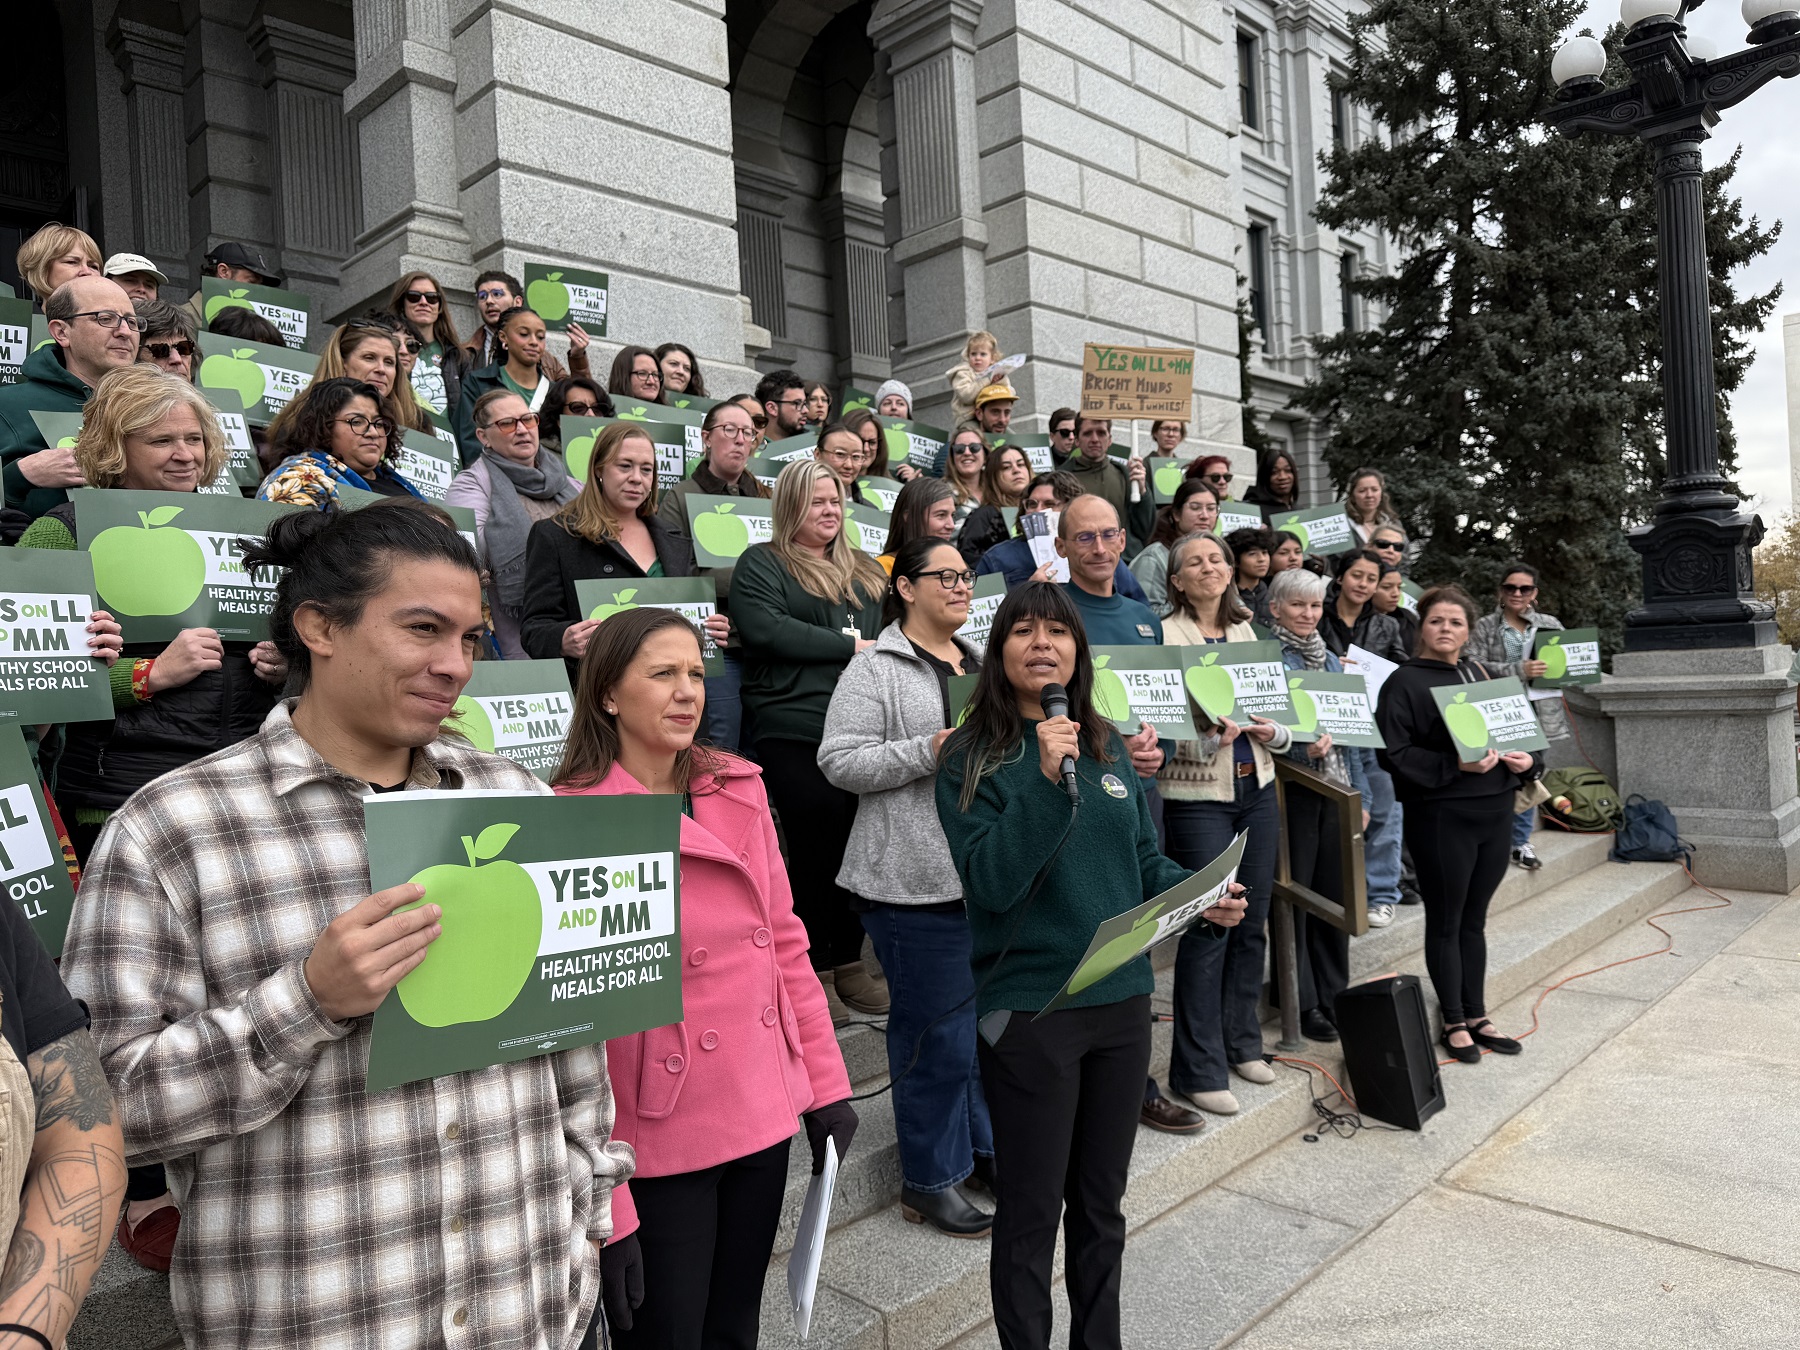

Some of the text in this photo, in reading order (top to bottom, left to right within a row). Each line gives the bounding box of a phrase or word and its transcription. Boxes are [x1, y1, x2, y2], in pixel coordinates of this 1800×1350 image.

[572, 287, 588, 297] YES
[596, 291, 604, 300] LL
[586, 300, 599, 310] MM
[260, 306, 281, 319] YES
[292, 312, 304, 323] LL
[277, 321, 296, 333] MM
[5, 329, 22, 344] LL
[1092, 347, 1127, 371] YES
[1131, 355, 1146, 371] ON
[1149, 356, 1165, 372] LL
[0, 366, 22, 375] HOOL
[270, 369, 300, 385] YES
[2, 376, 17, 384] ALL
[1085, 372, 1173, 394] BRIGHT MINDS
[273, 384, 293, 393] AND
[1083, 394, 1184, 411] NEED FULL TUMMIES!
[222, 416, 241, 430] LL
[688, 428, 699, 438] LL
[912, 436, 927, 446] YES
[666, 447, 679, 459] LL
[420, 458, 431, 467] ON
[432, 460, 448, 474] LL
[657, 461, 671, 472] M
[413, 467, 440, 484] MM
[424, 483, 447, 495] SCHOO
[1249, 517, 1258, 525] LL
[1308, 521, 1324, 530] YES
[1333, 516, 1344, 524] LL
[862, 526, 881, 539] YES
[1324, 526, 1340, 534] MM
[208, 537, 244, 557] YE
[208, 588, 261, 601] HEALTHY
[21, 604, 48, 617] ON
[50, 600, 86, 622] LL
[218, 601, 275, 614] MEALS FO
[975, 603, 987, 612] ON
[13, 628, 70, 651] MM
[1566, 646, 1581, 654] YES
[32, 660, 96, 674] SCHOOL
[1233, 667, 1257, 679] YES
[1268, 665, 1281, 677] LL
[27, 677, 58, 690] FOR
[61, 676, 89, 689] ALL
[1125, 673, 1151, 686] YES
[1163, 673, 1179, 686] LL
[1256, 680, 1276, 692] MM
[1150, 689, 1173, 702] MM
[1237, 695, 1289, 706] HEALTHY SCHOOL
[1316, 694, 1339, 705] YES
[1351, 696, 1365, 706] LL
[490, 697, 568, 720] YES ON LL
[1131, 706, 1186, 715] HEALTHY SCHOOL
[1242, 703, 1288, 713] MEALS FOR ALL
[1481, 702, 1503, 714] YES
[1512, 698, 1526, 708] LL
[1139, 715, 1185, 723] MEALS FOR ALL
[1338, 708, 1361, 719] MM
[1503, 711, 1525, 723] MM
[502, 719, 562, 739] AND MM
[0, 798, 29, 829] L
[10, 875, 54, 900] OOL
[548, 861, 667, 902] YES ON LL
[24, 900, 47, 919] LL
[1165, 899, 1202, 927] YES
[1202, 892, 1217, 907] ON
[558, 900, 651, 938] AND MM
[541, 941, 672, 980] HEALTHY SCHOOL
[551, 963, 664, 1002] MEALS FOR ALL
